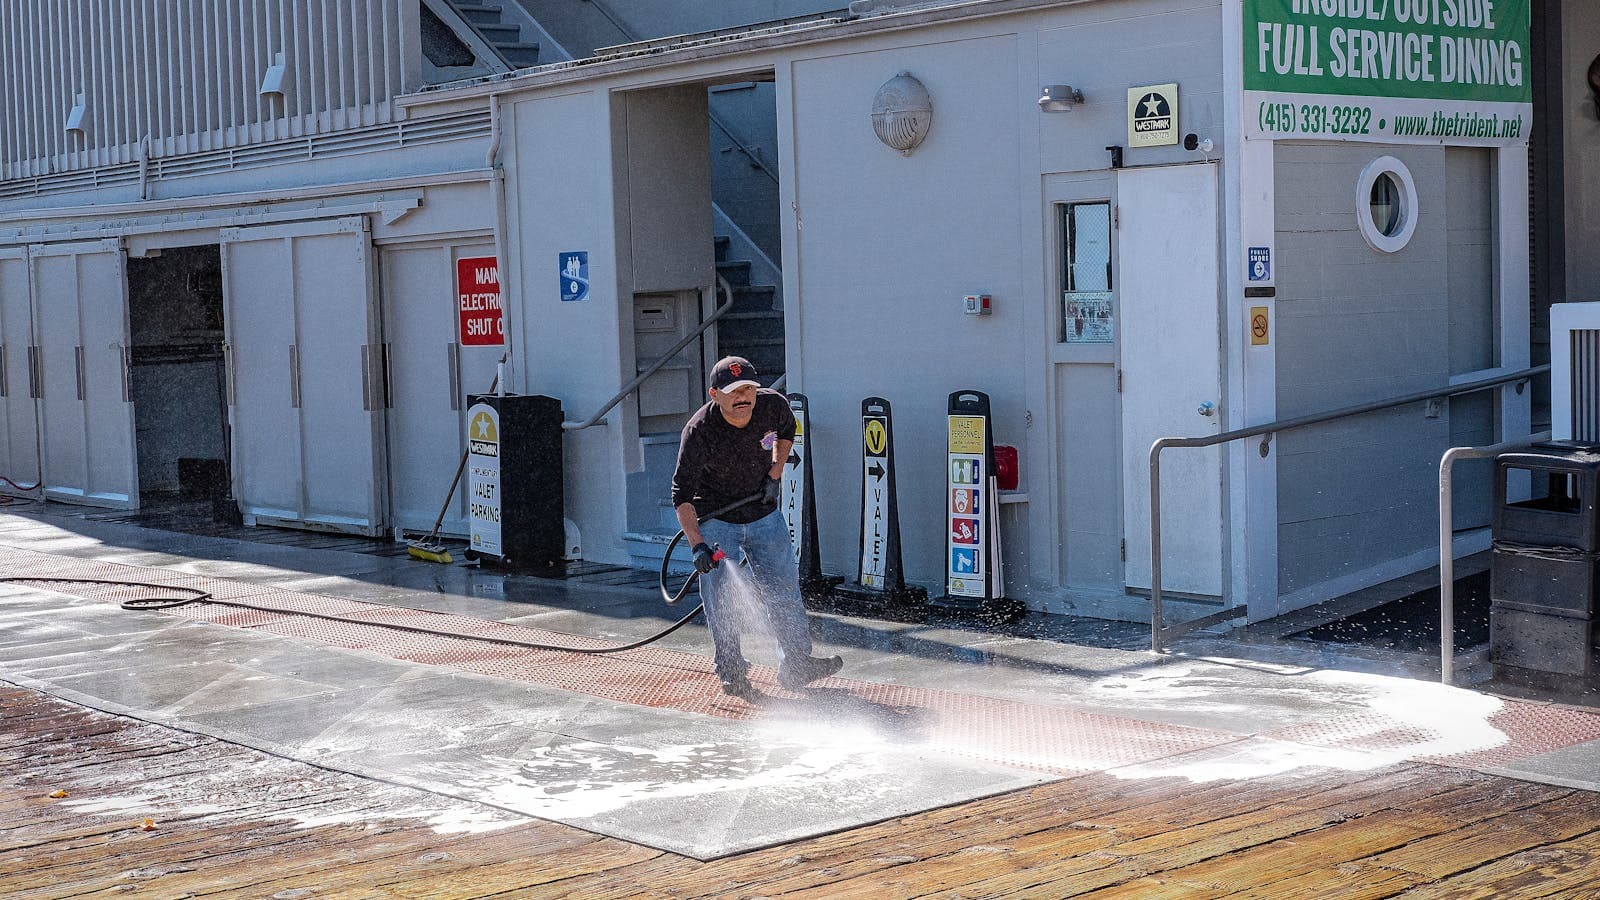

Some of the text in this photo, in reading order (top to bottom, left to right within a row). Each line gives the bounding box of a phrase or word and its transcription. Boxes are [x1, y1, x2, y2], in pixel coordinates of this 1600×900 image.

[1291, 0, 1496, 30] OUTSIDE
[1257, 21, 1523, 87] FULL SERVICE DINING
[1135, 119, 1170, 131] WESTPARK
[1258, 101, 1523, 138] (415) 331-3232 www.thetrident.net
[475, 267, 499, 285] MAIN
[467, 316, 492, 336] SHUT
[869, 430, 881, 451] V
[474, 482, 495, 500] VALET
[471, 503, 500, 523] PARKING
[788, 479, 797, 543] VALE
[873, 488, 882, 571] VALET
